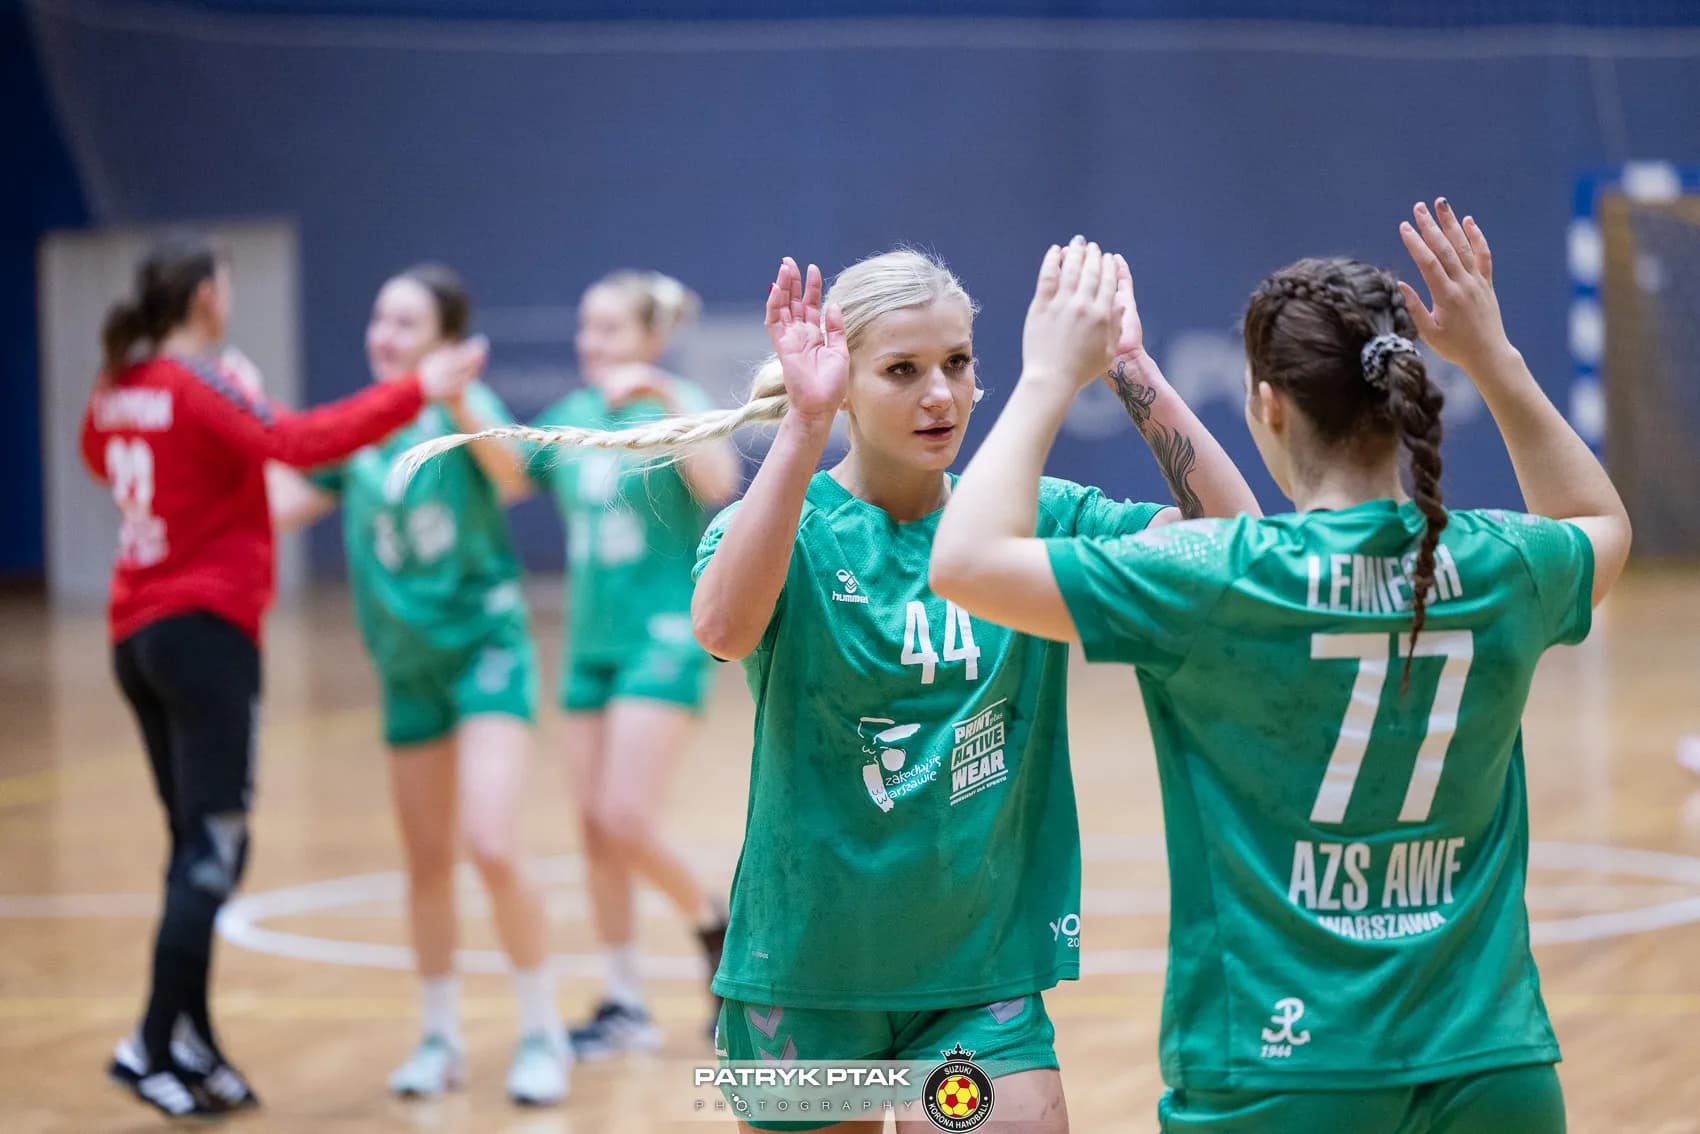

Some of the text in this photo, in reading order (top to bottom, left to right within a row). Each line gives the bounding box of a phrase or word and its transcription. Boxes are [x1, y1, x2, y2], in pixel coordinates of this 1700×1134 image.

[832, 590, 869, 604] hummel
[901, 599, 980, 684] 44
[952, 723, 1004, 769] ACTIVE
[955, 710, 993, 745] PRINT
[1310, 630, 1474, 823] 77
[886, 758, 930, 786] zakochaj
[952, 749, 1005, 793] WEAR
[1288, 837, 1465, 911] AZS AWF
[1317, 911, 1447, 940] WARSZAWA
[1260, 1044, 1292, 1058] 1944
